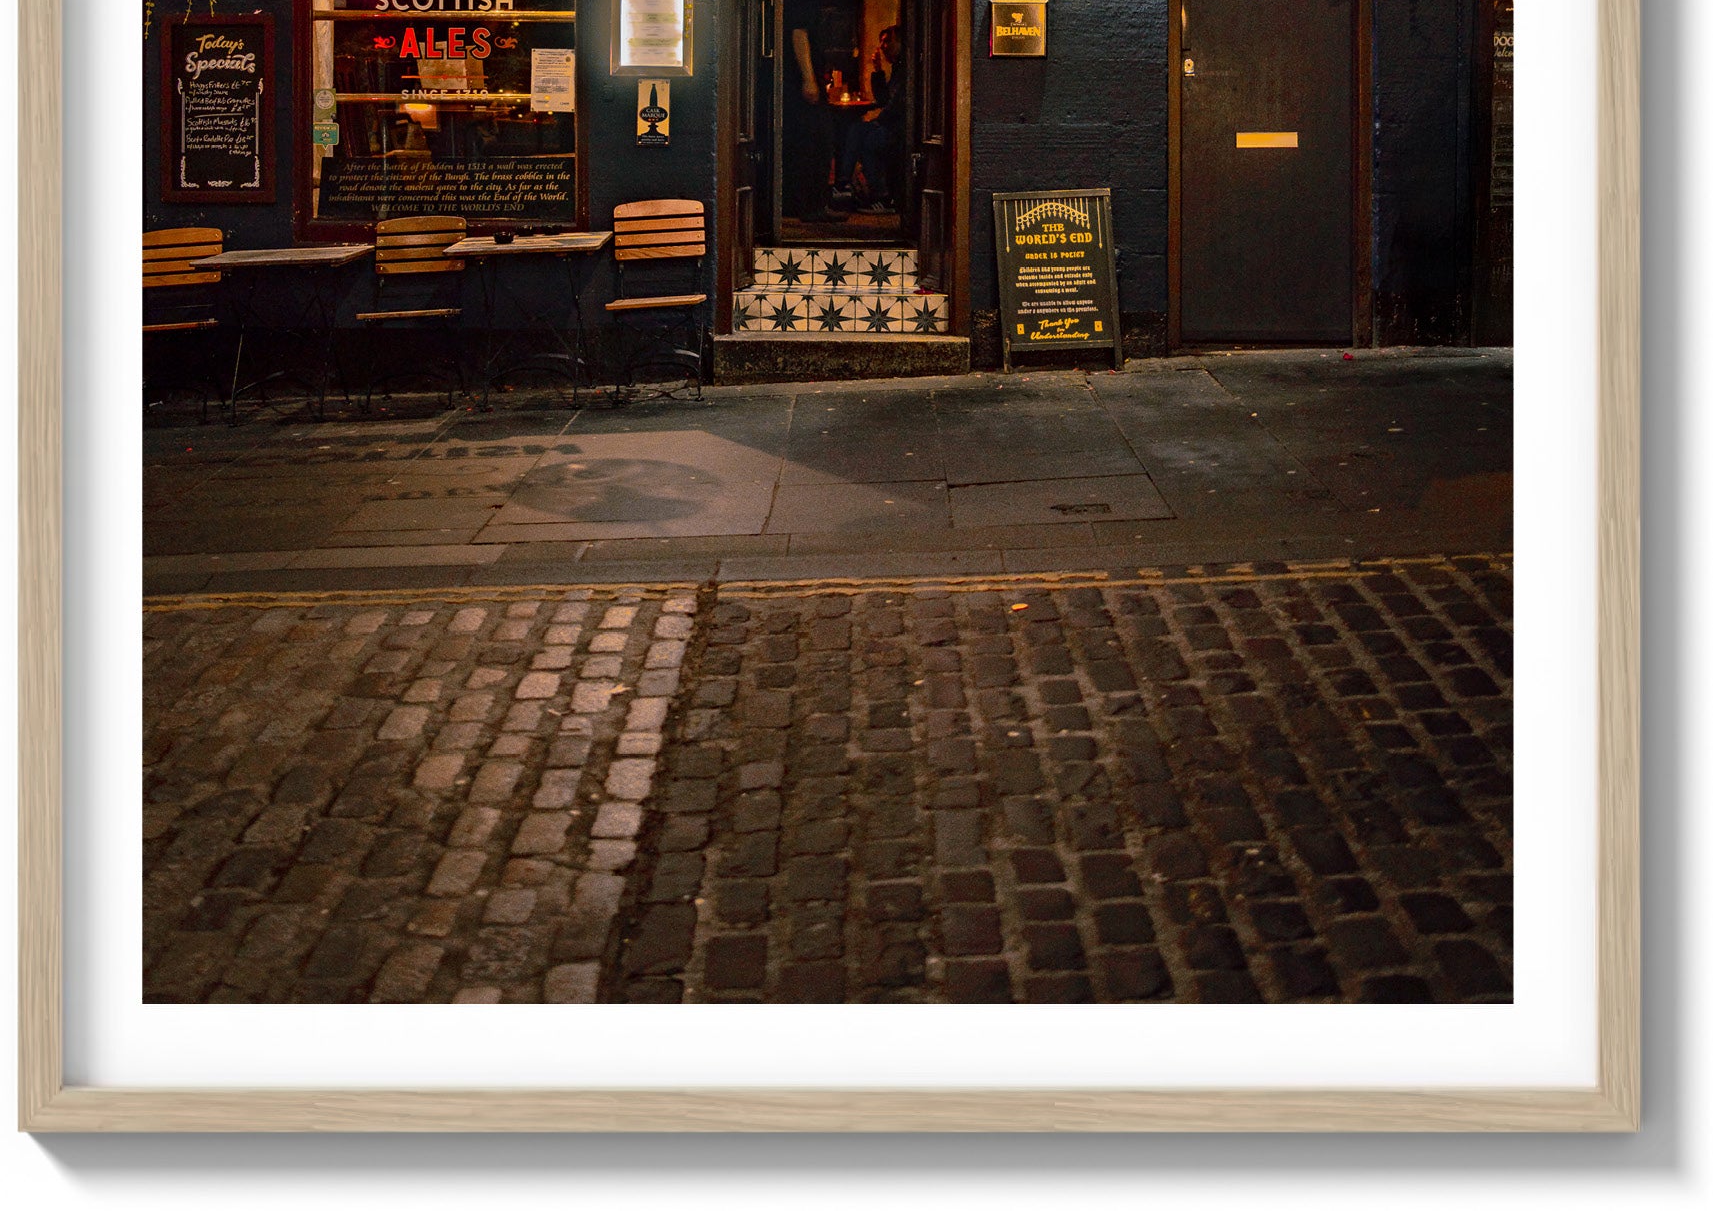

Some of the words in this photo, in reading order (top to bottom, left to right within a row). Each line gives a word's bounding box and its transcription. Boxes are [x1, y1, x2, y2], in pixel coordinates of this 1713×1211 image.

[996, 25, 1041, 37] BELHAVEN
[195, 33, 245, 55] Today's
[399, 27, 493, 60] ALES
[185, 51, 256, 80] Specials
[401, 89, 448, 100] SINCE
[456, 89, 489, 100] 1719
[367, 163, 380, 171] the
[410, 162, 420, 174] of
[456, 162, 465, 171] in
[496, 161, 516, 171] wall
[535, 161, 565, 170] erected
[339, 173, 368, 183] protect
[370, 173, 384, 181] the
[418, 172, 428, 183] of
[429, 172, 443, 181] the
[474, 172, 489, 181] The
[491, 172, 513, 181] brass
[514, 172, 543, 181] cobbles
[545, 172, 555, 181] in
[557, 171, 571, 181] the
[339, 182, 358, 191] road
[388, 182, 401, 191] the
[404, 182, 434, 191] ancient
[436, 183, 458, 195] gates
[459, 183, 468, 191] to
[470, 182, 483, 191] the
[505, 183, 517, 191] As
[518, 181, 532, 194] far
[545, 181, 559, 191] the
[377, 193, 396, 201] were
[398, 192, 439, 201] concerned
[441, 192, 457, 201] this
[478, 192, 491, 201] the
[494, 192, 511, 201] End
[512, 192, 522, 204] of
[524, 192, 537, 201] the
[540, 192, 569, 201] World.
[371, 203, 420, 212] WELCOME
[422, 203, 435, 212] TO
[438, 203, 458, 212] THE
[503, 203, 525, 211] END
[1042, 223, 1065, 233] THE
[1015, 233, 1067, 245] WORLD'S
[1069, 232, 1093, 244] END
[1025, 252, 1048, 260] UNDER
[1060, 250, 1085, 259] POLICY
[1038, 318, 1064, 331] Thank
[1064, 317, 1080, 330] You
[1030, 330, 1091, 341] Understanding
